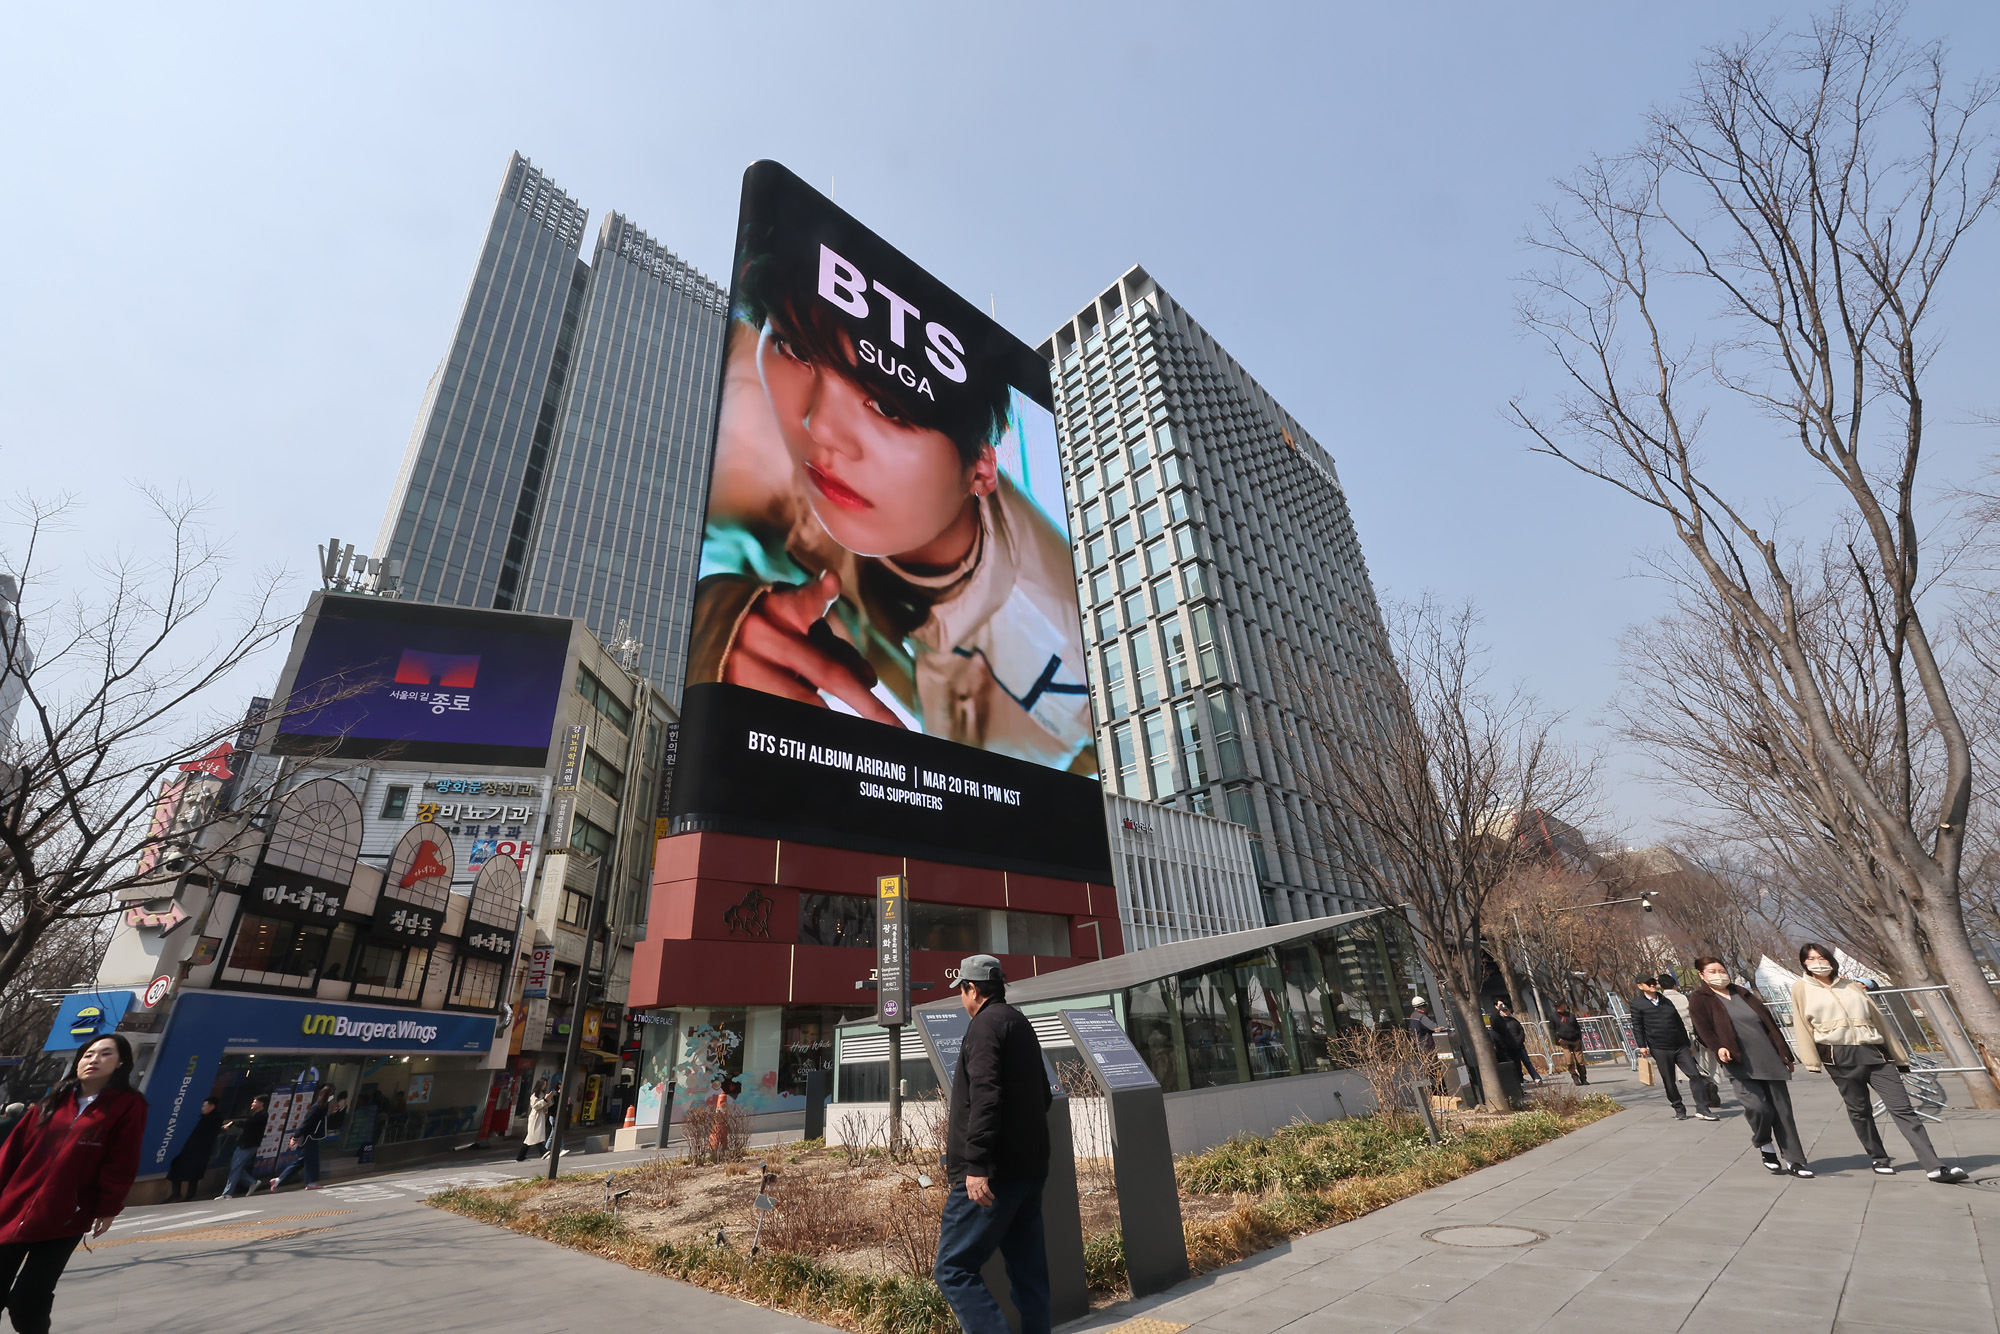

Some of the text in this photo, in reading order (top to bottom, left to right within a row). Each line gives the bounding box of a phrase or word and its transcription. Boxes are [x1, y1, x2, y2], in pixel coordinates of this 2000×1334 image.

[818, 243, 967, 383] BTS
[858, 339, 935, 401] SUGA
[389, 690, 470, 714] 서울의 길 종로
[748, 730, 1021, 806] BTS 5TH ALBUM ARIRANG MAR 20 FRI 1PM KST
[859, 781, 943, 811] SUGA SUPPORTERS
[464, 825, 521, 839] 피부과
[885, 900, 894, 912] 7
[390, 909, 433, 937] 청담동
[883, 923, 891, 964] 광화문
[530, 950, 551, 988] 약국
[149, 983, 165, 1000] 30
